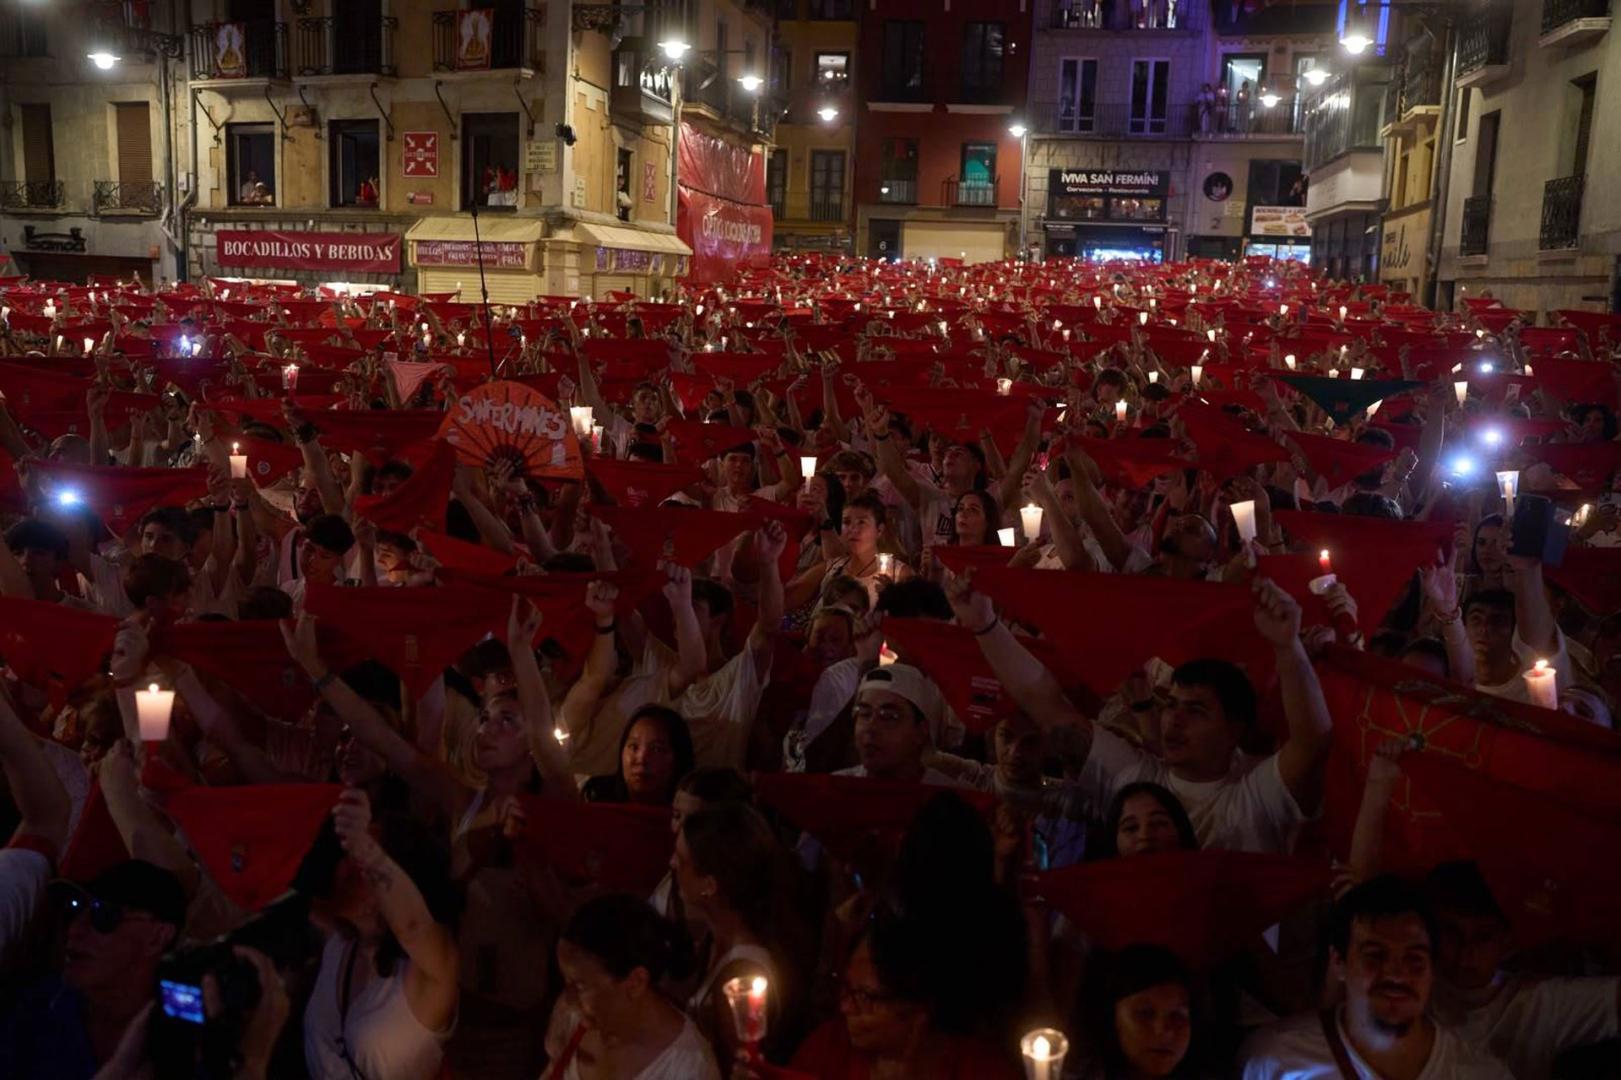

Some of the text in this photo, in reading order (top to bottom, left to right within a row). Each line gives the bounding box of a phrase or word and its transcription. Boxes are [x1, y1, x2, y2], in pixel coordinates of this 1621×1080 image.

[223, 241, 393, 261] BOCADILLOS Y BEBIDAS
